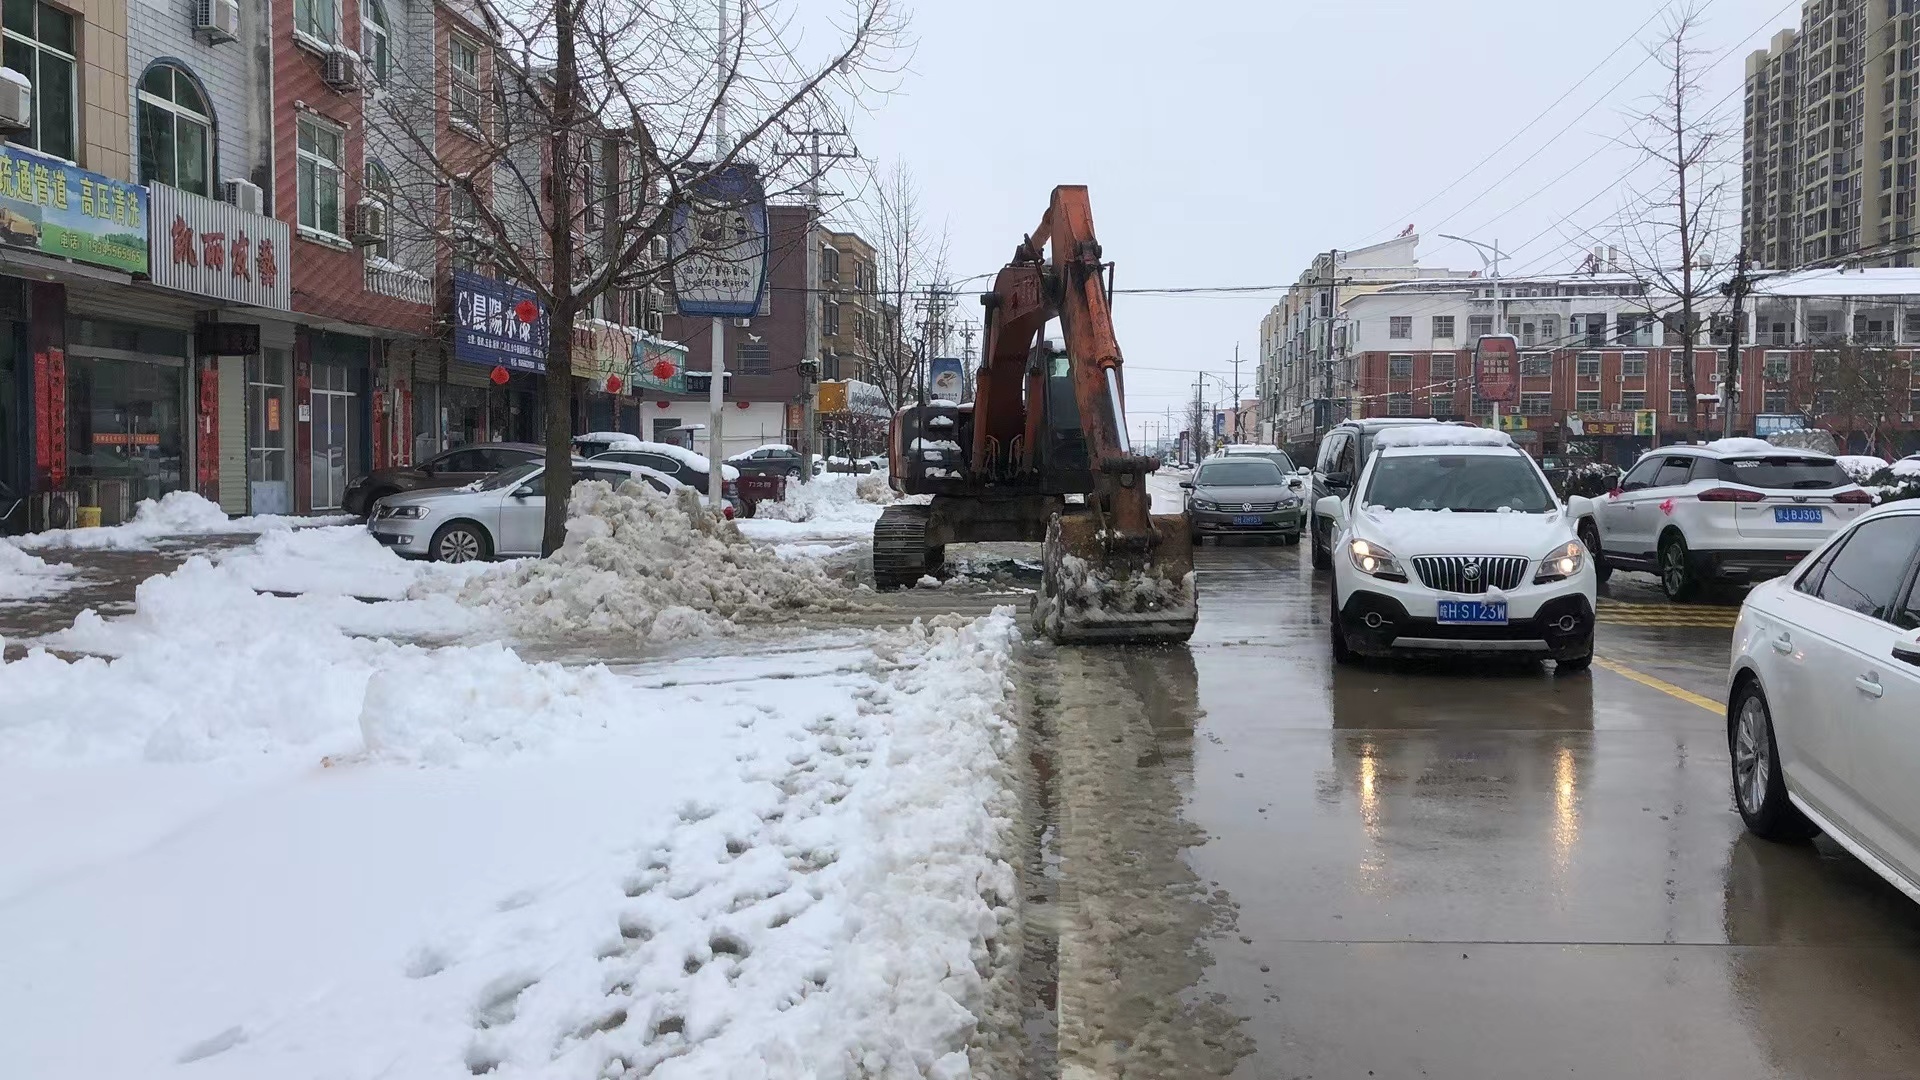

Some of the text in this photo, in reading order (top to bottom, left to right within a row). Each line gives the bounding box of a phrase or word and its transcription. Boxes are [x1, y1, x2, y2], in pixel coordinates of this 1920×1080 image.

[0, 154, 141, 228] 疏通管道 高压清洗
